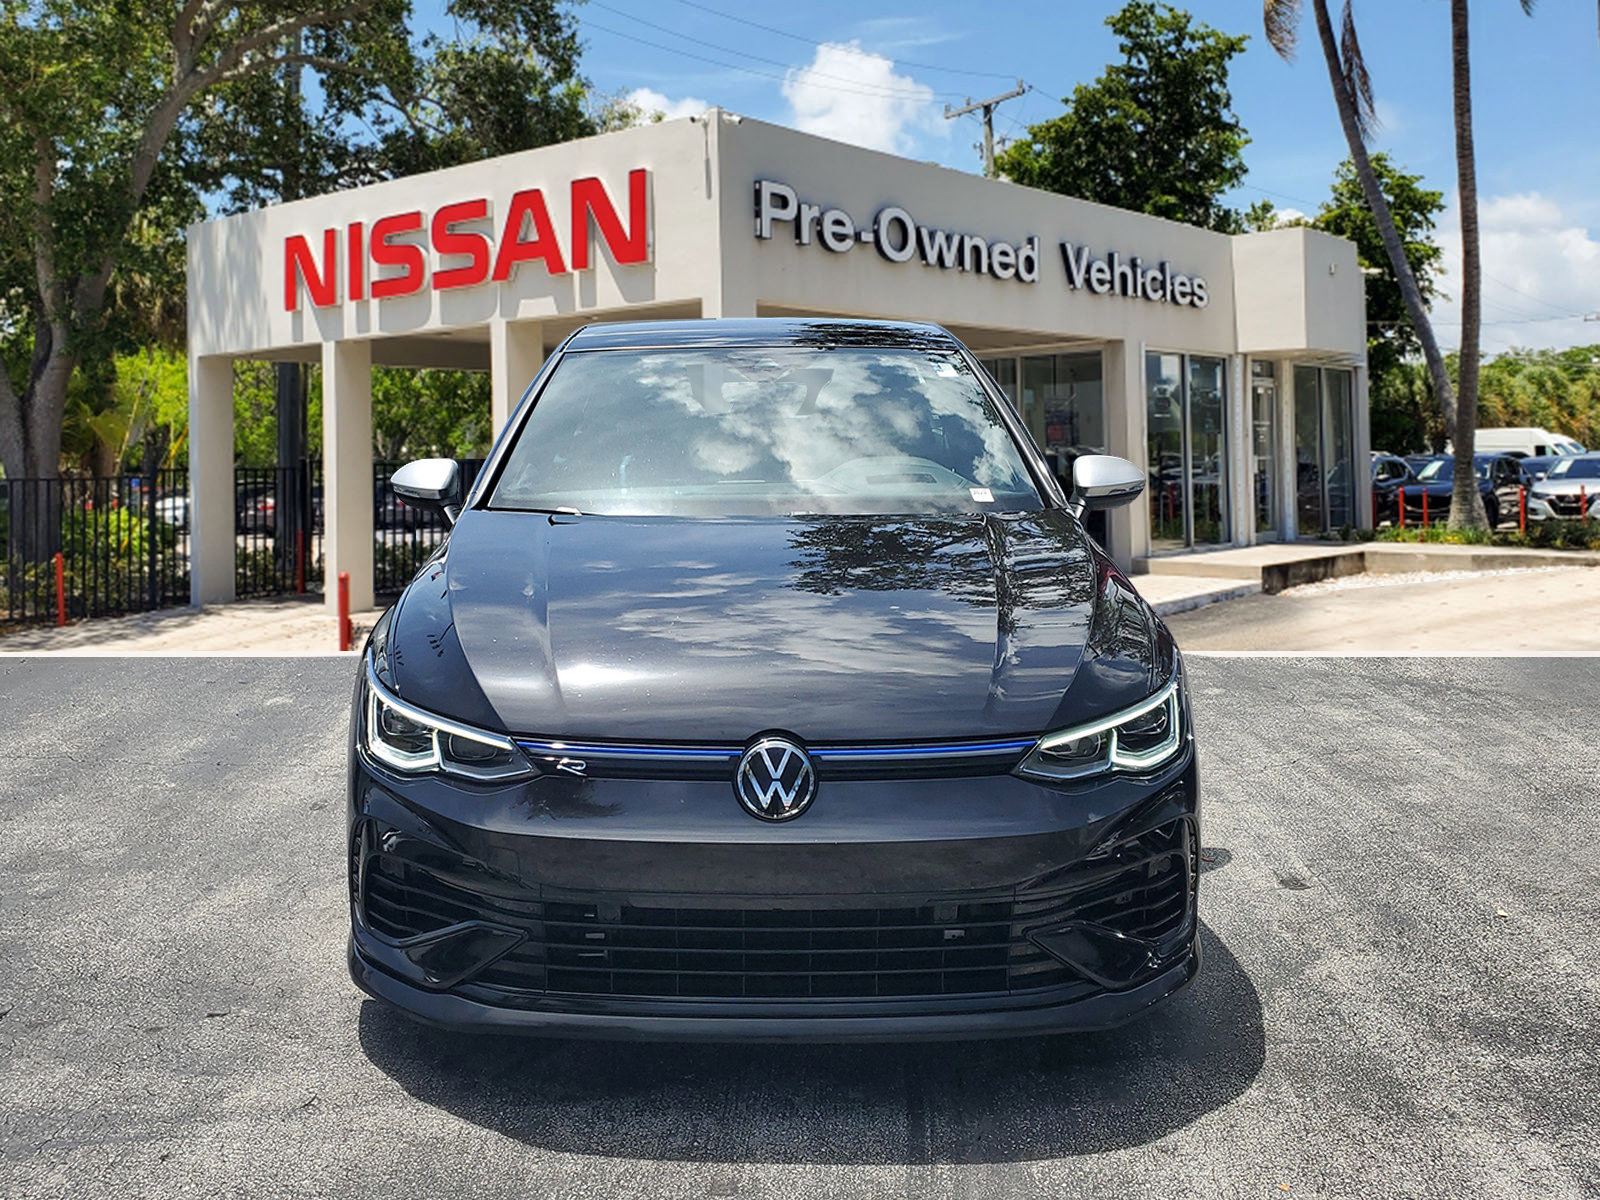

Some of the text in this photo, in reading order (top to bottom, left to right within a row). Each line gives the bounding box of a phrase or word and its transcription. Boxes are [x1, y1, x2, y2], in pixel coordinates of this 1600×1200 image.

[284, 168, 648, 312] NISSAN
[754, 180, 1209, 308] Pre-Owned Vehicles
